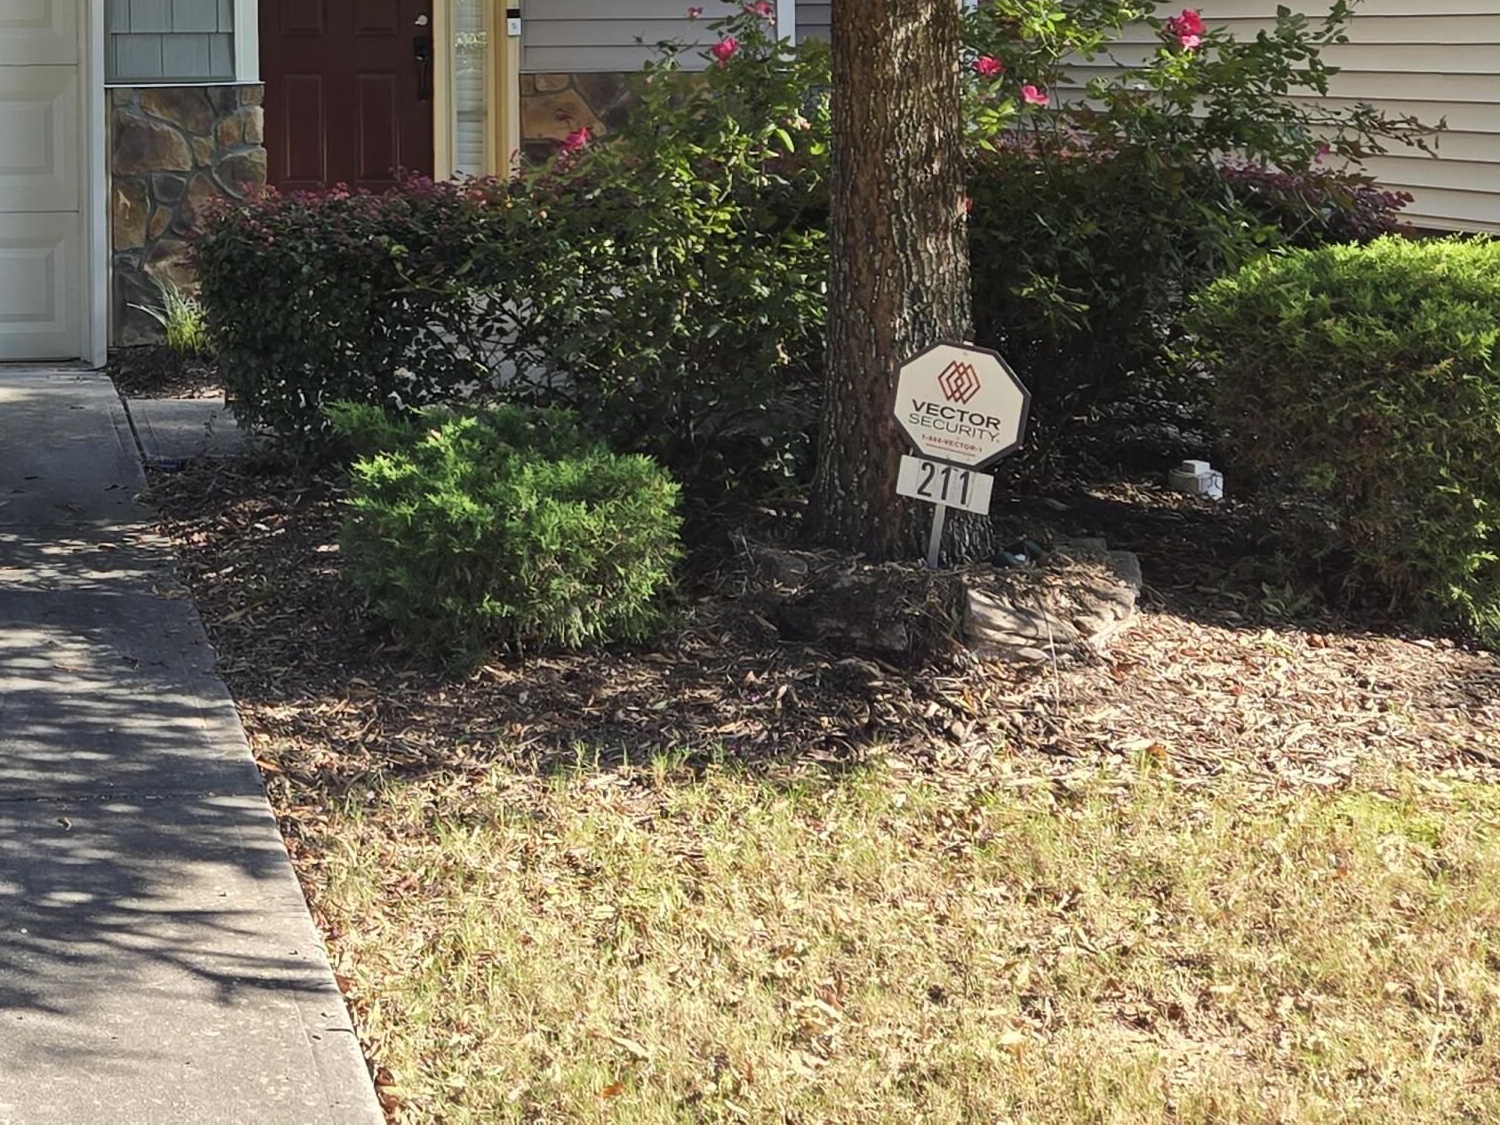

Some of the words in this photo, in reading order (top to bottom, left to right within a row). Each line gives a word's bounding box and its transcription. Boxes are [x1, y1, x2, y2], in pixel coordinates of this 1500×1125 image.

[908, 413, 1000, 442] SECURITY
[911, 398, 1001, 430] VECTOR
[916, 461, 971, 505] 211
